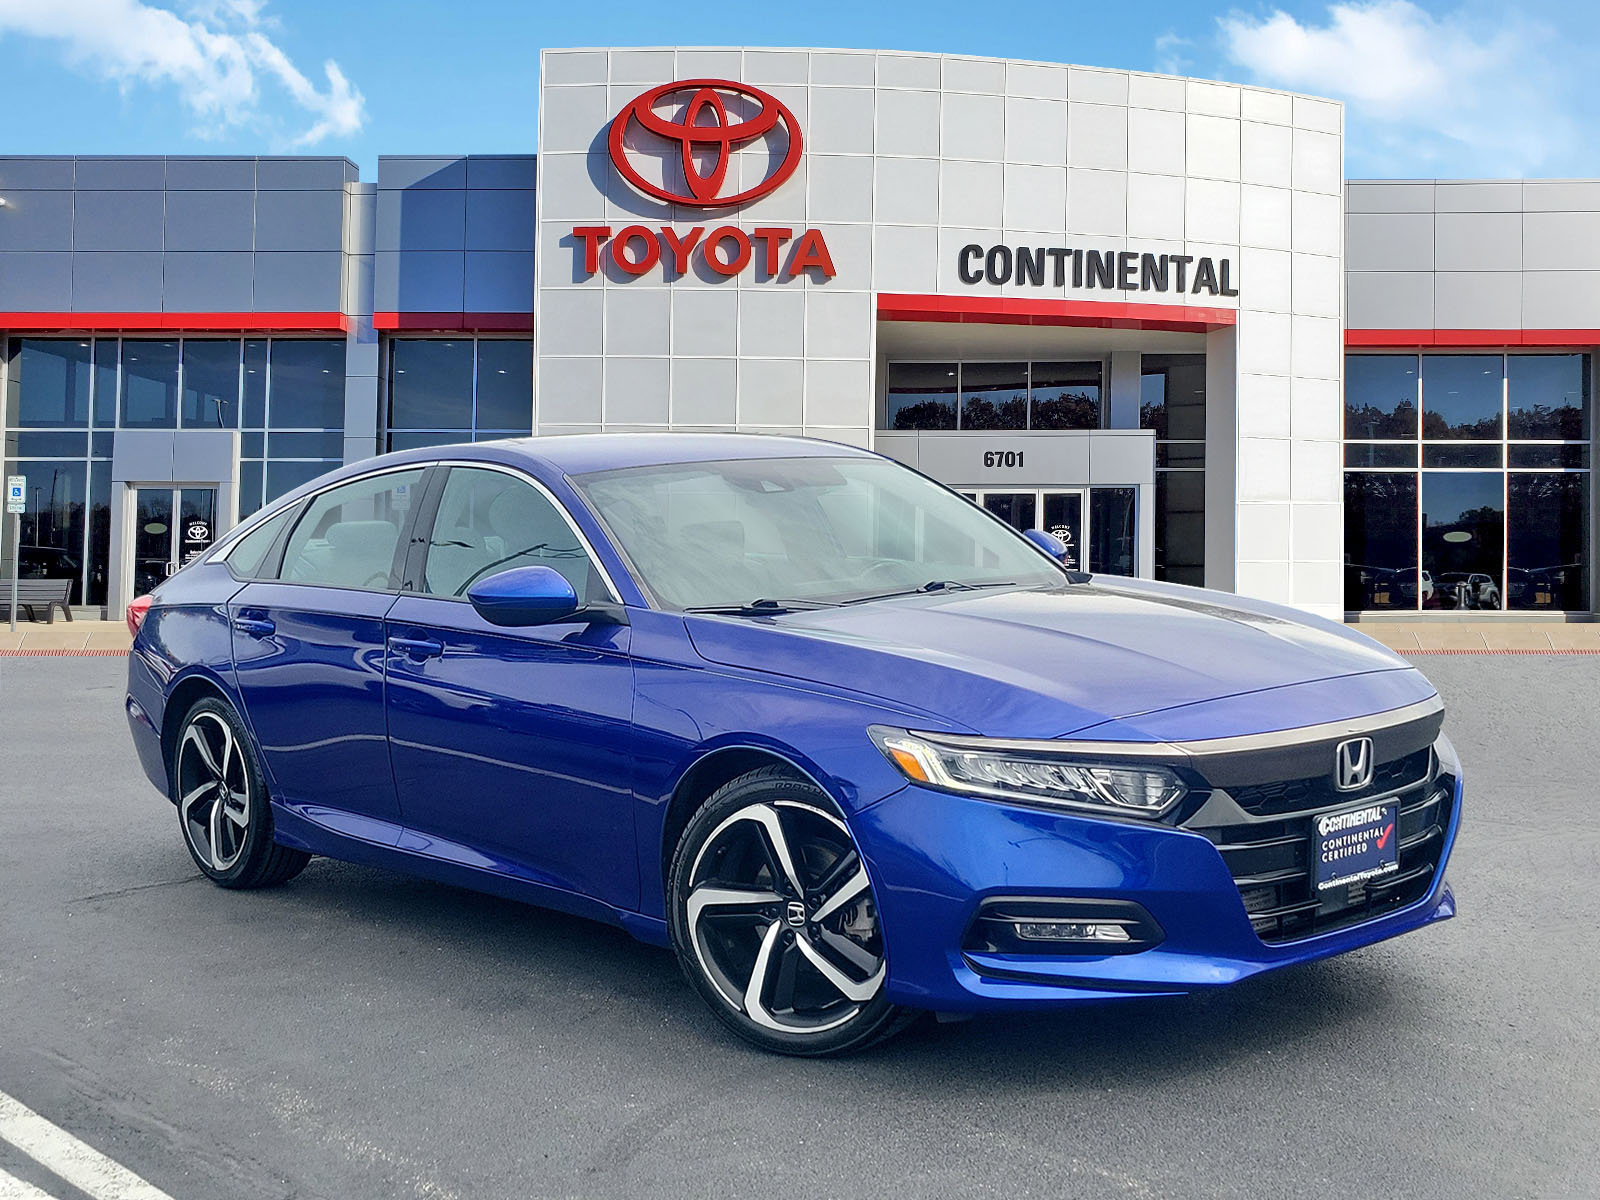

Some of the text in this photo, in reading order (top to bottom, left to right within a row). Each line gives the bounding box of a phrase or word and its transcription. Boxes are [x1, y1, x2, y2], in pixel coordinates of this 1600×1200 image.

[573, 225, 836, 277] TOYOTA
[959, 244, 1239, 296] CONTINENTAL
[983, 451, 1024, 468] 6701
[1318, 806, 1381, 836] CONTINENTAL
[1322, 826, 1384, 851] CONTINENTAL
[1322, 842, 1368, 862] CERTIFIED
